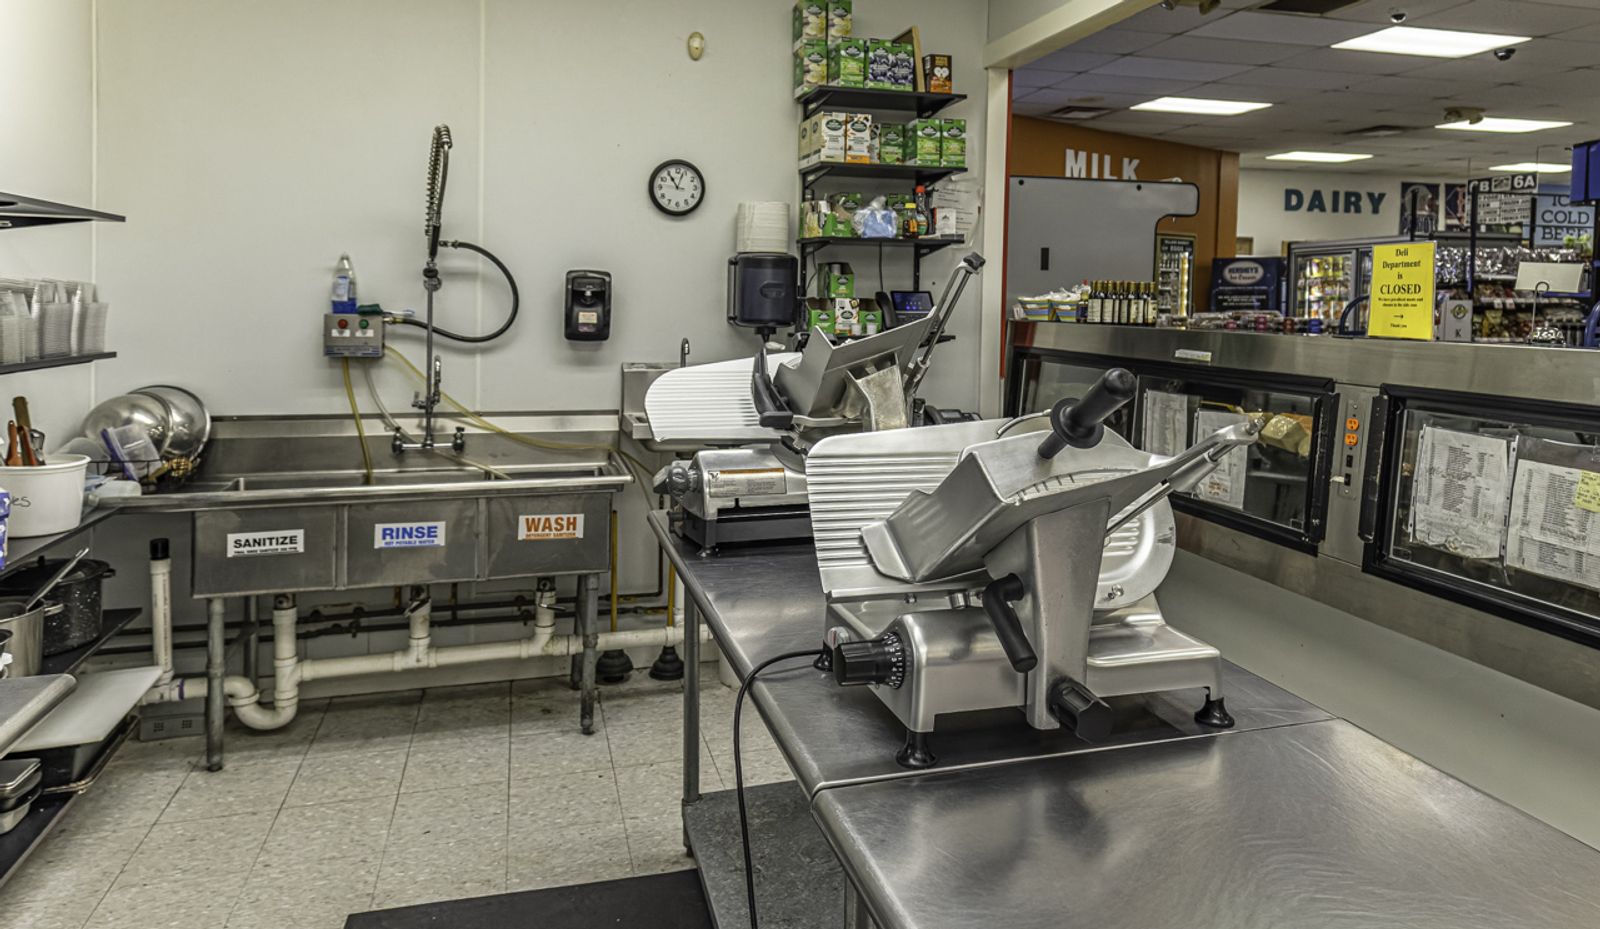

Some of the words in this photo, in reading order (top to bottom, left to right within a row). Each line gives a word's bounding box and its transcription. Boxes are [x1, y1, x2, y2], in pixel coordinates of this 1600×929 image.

[1065, 148, 1141, 181] MILK
[1513, 175, 1535, 188] 6A
[1284, 188, 1387, 215] DAIRY
[1552, 195, 1570, 207] IC
[1541, 209, 1590, 225] COLD
[1395, 248, 1409, 257] Deli
[1382, 260, 1421, 270] Department
[1397, 272, 1403, 280] is
[1380, 283, 1422, 295] CLOSED
[525, 516, 577, 532] WASH
[382, 526, 438, 540] RINSE
[233, 535, 298, 549] SANITIZE
